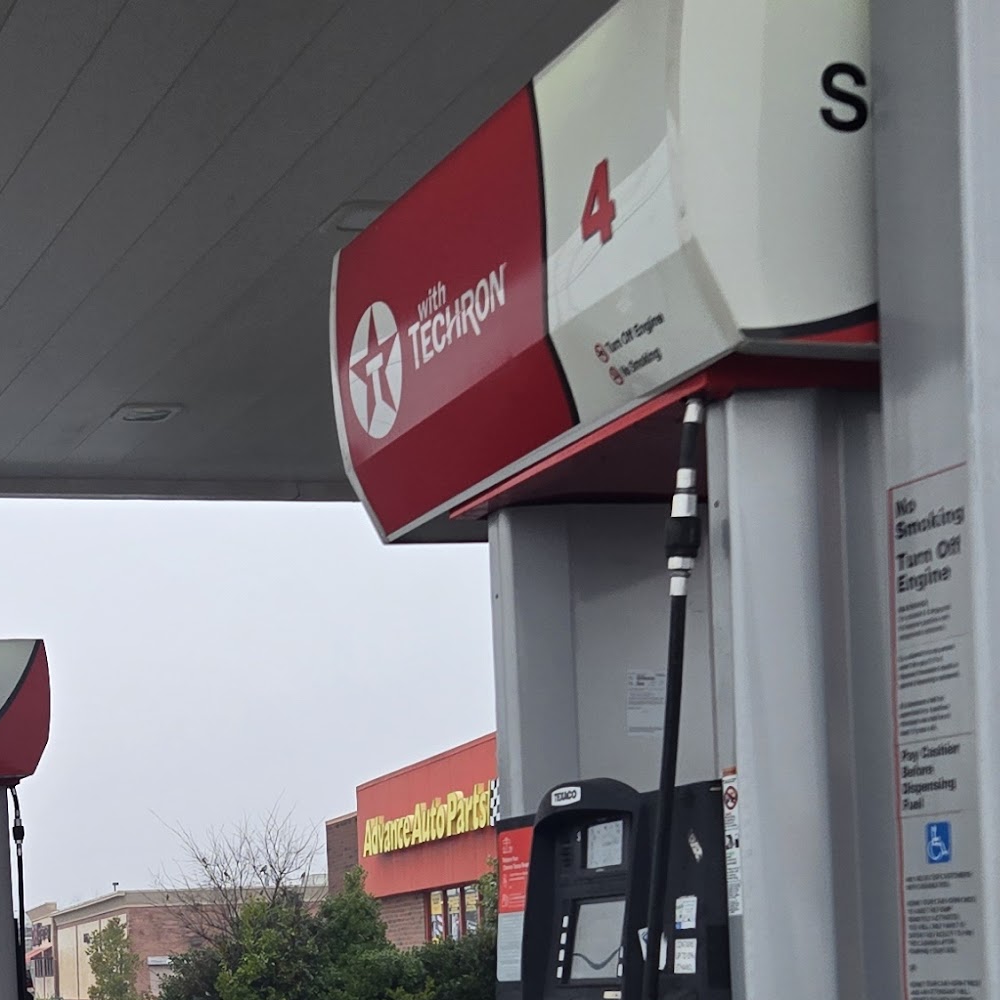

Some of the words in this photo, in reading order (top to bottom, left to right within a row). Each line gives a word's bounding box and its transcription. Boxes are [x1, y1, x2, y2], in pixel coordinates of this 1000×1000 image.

[581, 158, 617, 245] 4
[408, 262, 507, 370] TECHRON
[417, 281, 447, 322] with
[895, 497, 917, 518] No
[895, 505, 966, 540] Smoking
[896, 547, 933, 572] Turn
[935, 534, 962, 560] Off
[897, 565, 952, 594] Engine
[363, 815, 414, 857] Advance
[411, 801, 448, 846] Auto
[446, 783, 490, 837] Parts
